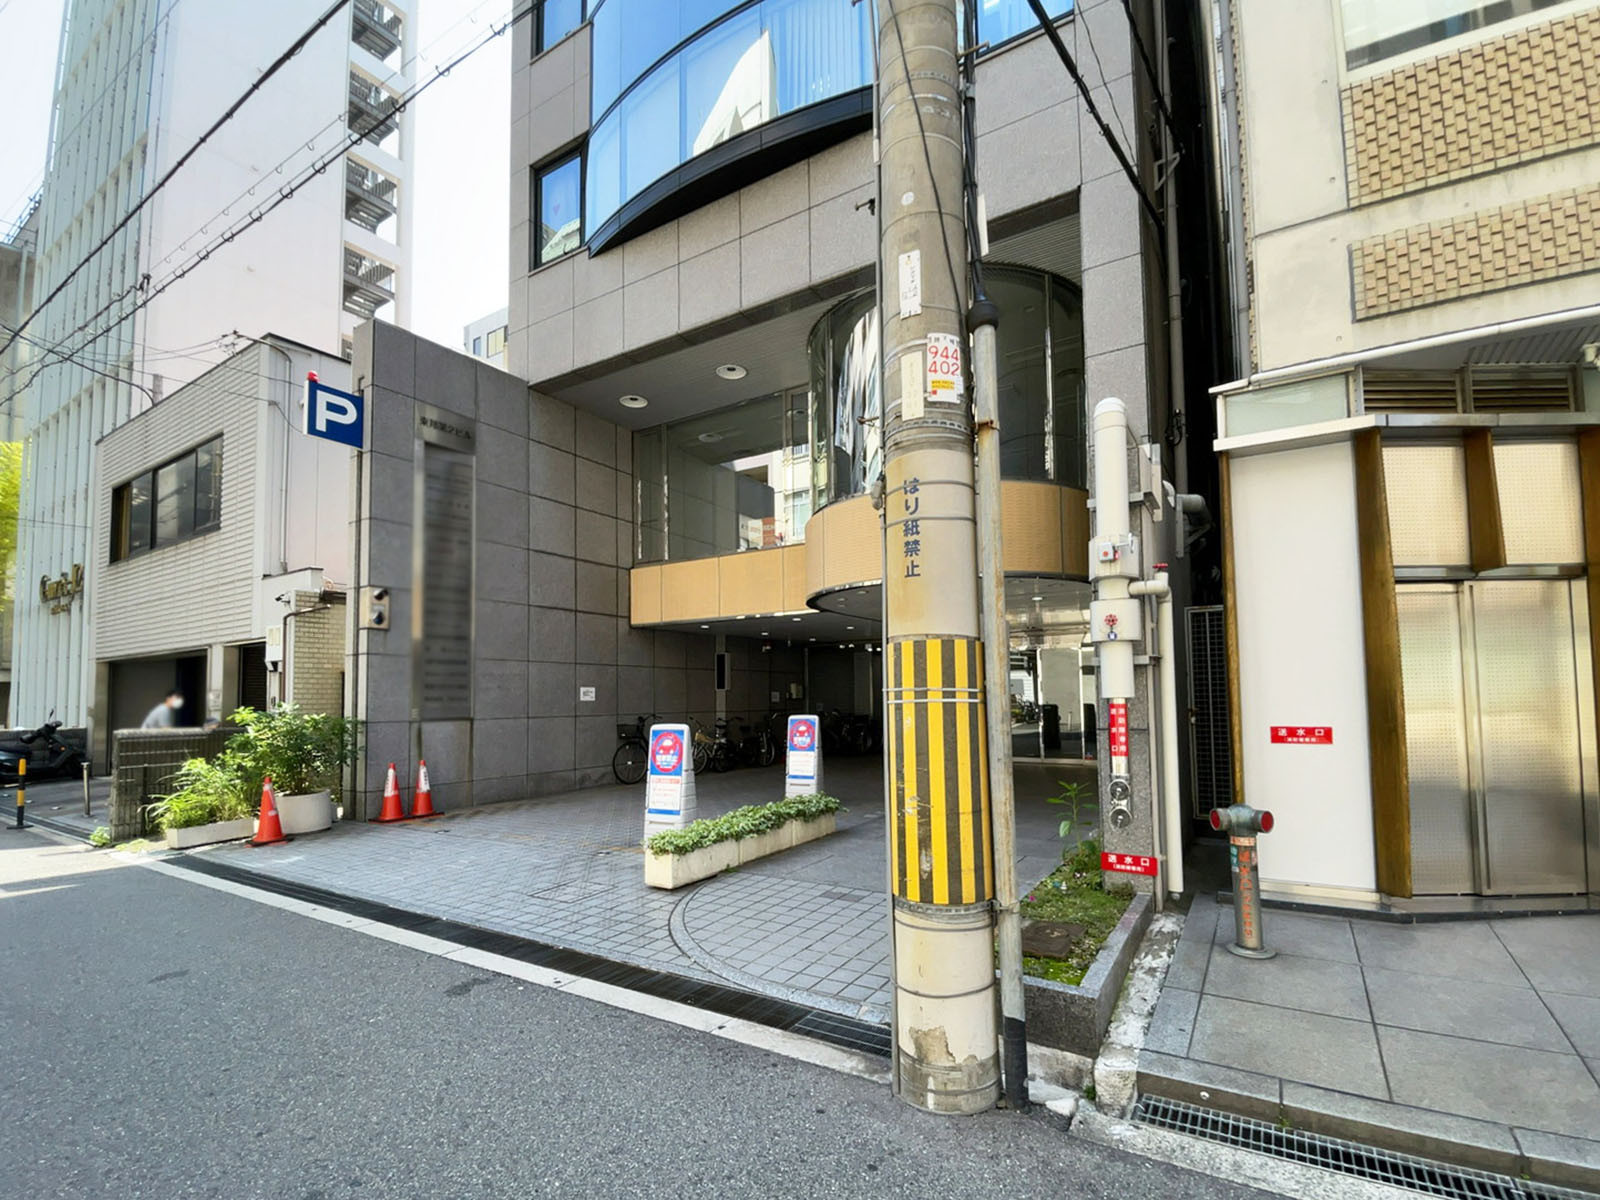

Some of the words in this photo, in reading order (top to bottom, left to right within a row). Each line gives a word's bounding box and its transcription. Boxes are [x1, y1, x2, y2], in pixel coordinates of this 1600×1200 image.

[928, 345, 959, 361] 944
[928, 361, 960, 376] 402
[316, 390, 357, 432] P
[903, 477, 920, 578] はり紙禁止
[1278, 728, 1325, 737] 送水口
[1107, 854, 1150, 867] 送水口
